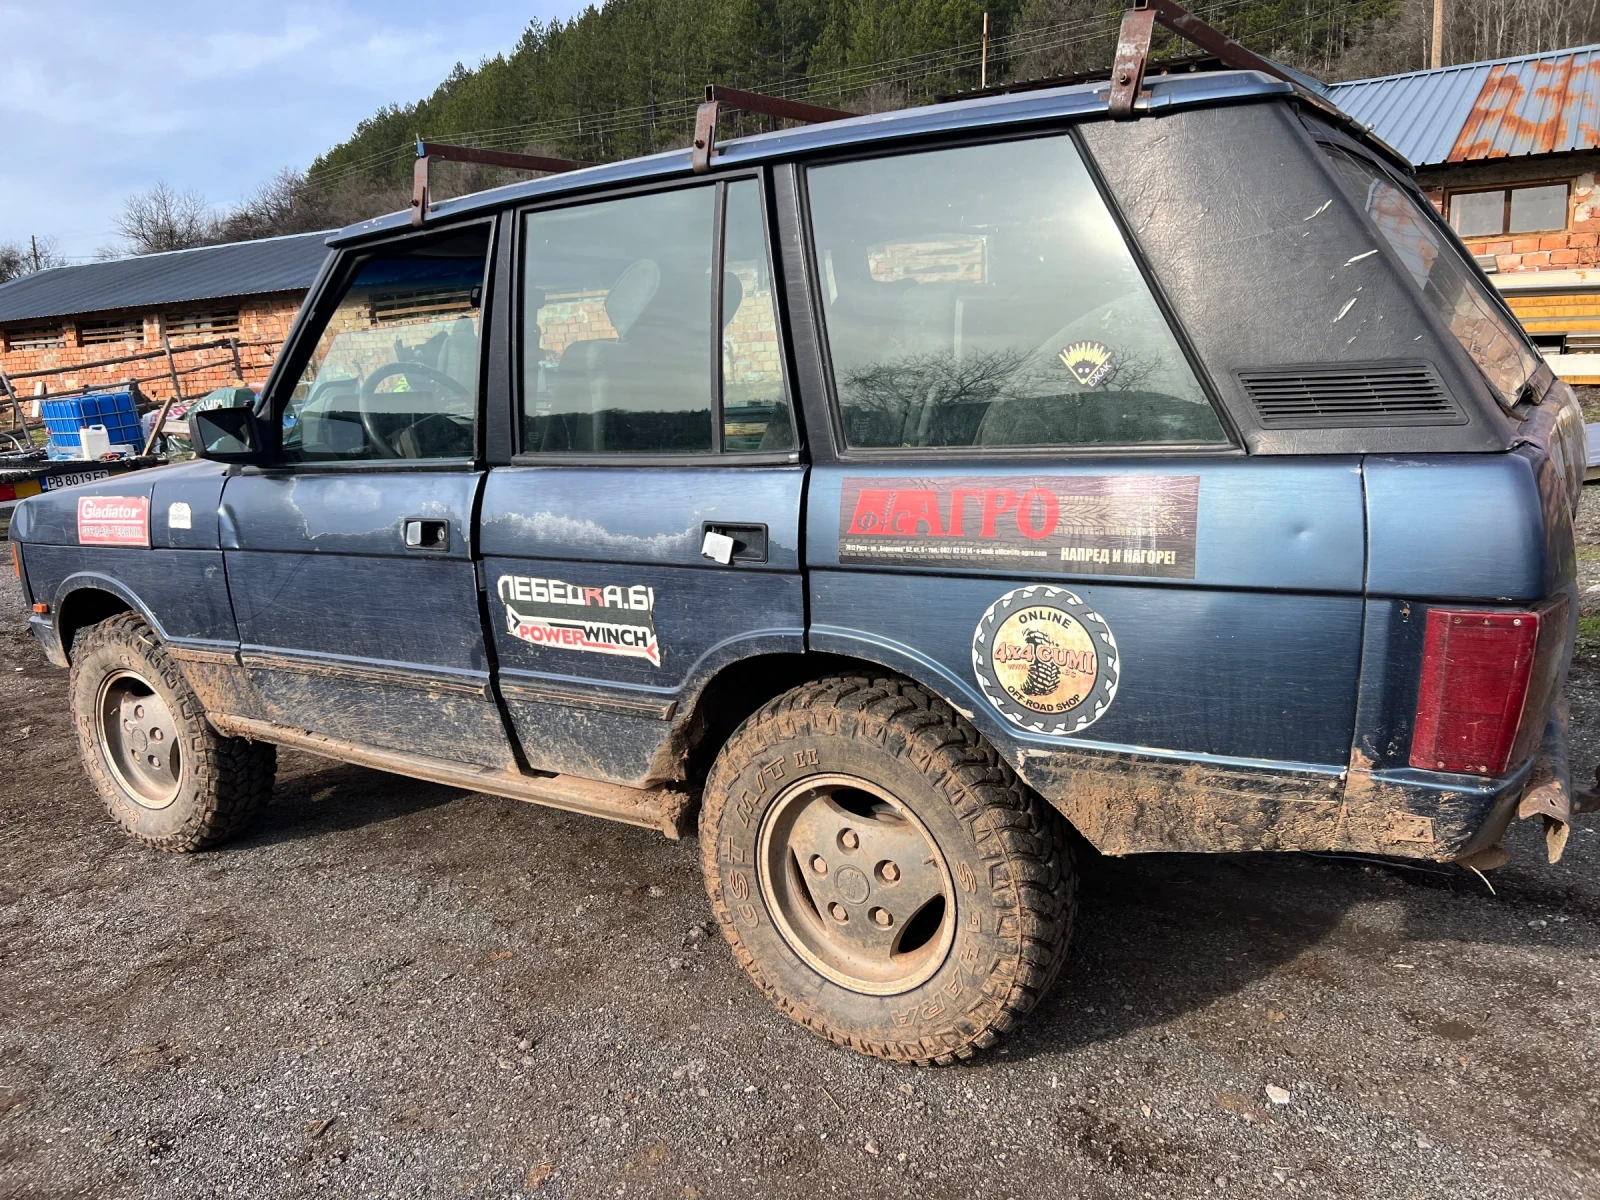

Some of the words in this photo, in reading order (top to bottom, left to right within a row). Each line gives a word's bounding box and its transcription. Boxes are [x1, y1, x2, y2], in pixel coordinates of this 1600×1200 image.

[65, 472, 91, 486] 8019
[81, 499, 143, 519] Gladiator
[847, 488, 1060, 540] АГРО
[81, 525, 144, 539] OFFROAD-TECHNIK
[1060, 547, 1110, 564] НАПРЕД
[1112, 549, 1121, 563] И
[1123, 549, 1176, 565] НАГОРЕ!
[1018, 610, 1072, 630] ONLINE
[519, 624, 648, 648] POWERWINCH
[1007, 685, 1054, 712] OFF-ROAD
[1055, 693, 1081, 711] SHOP
